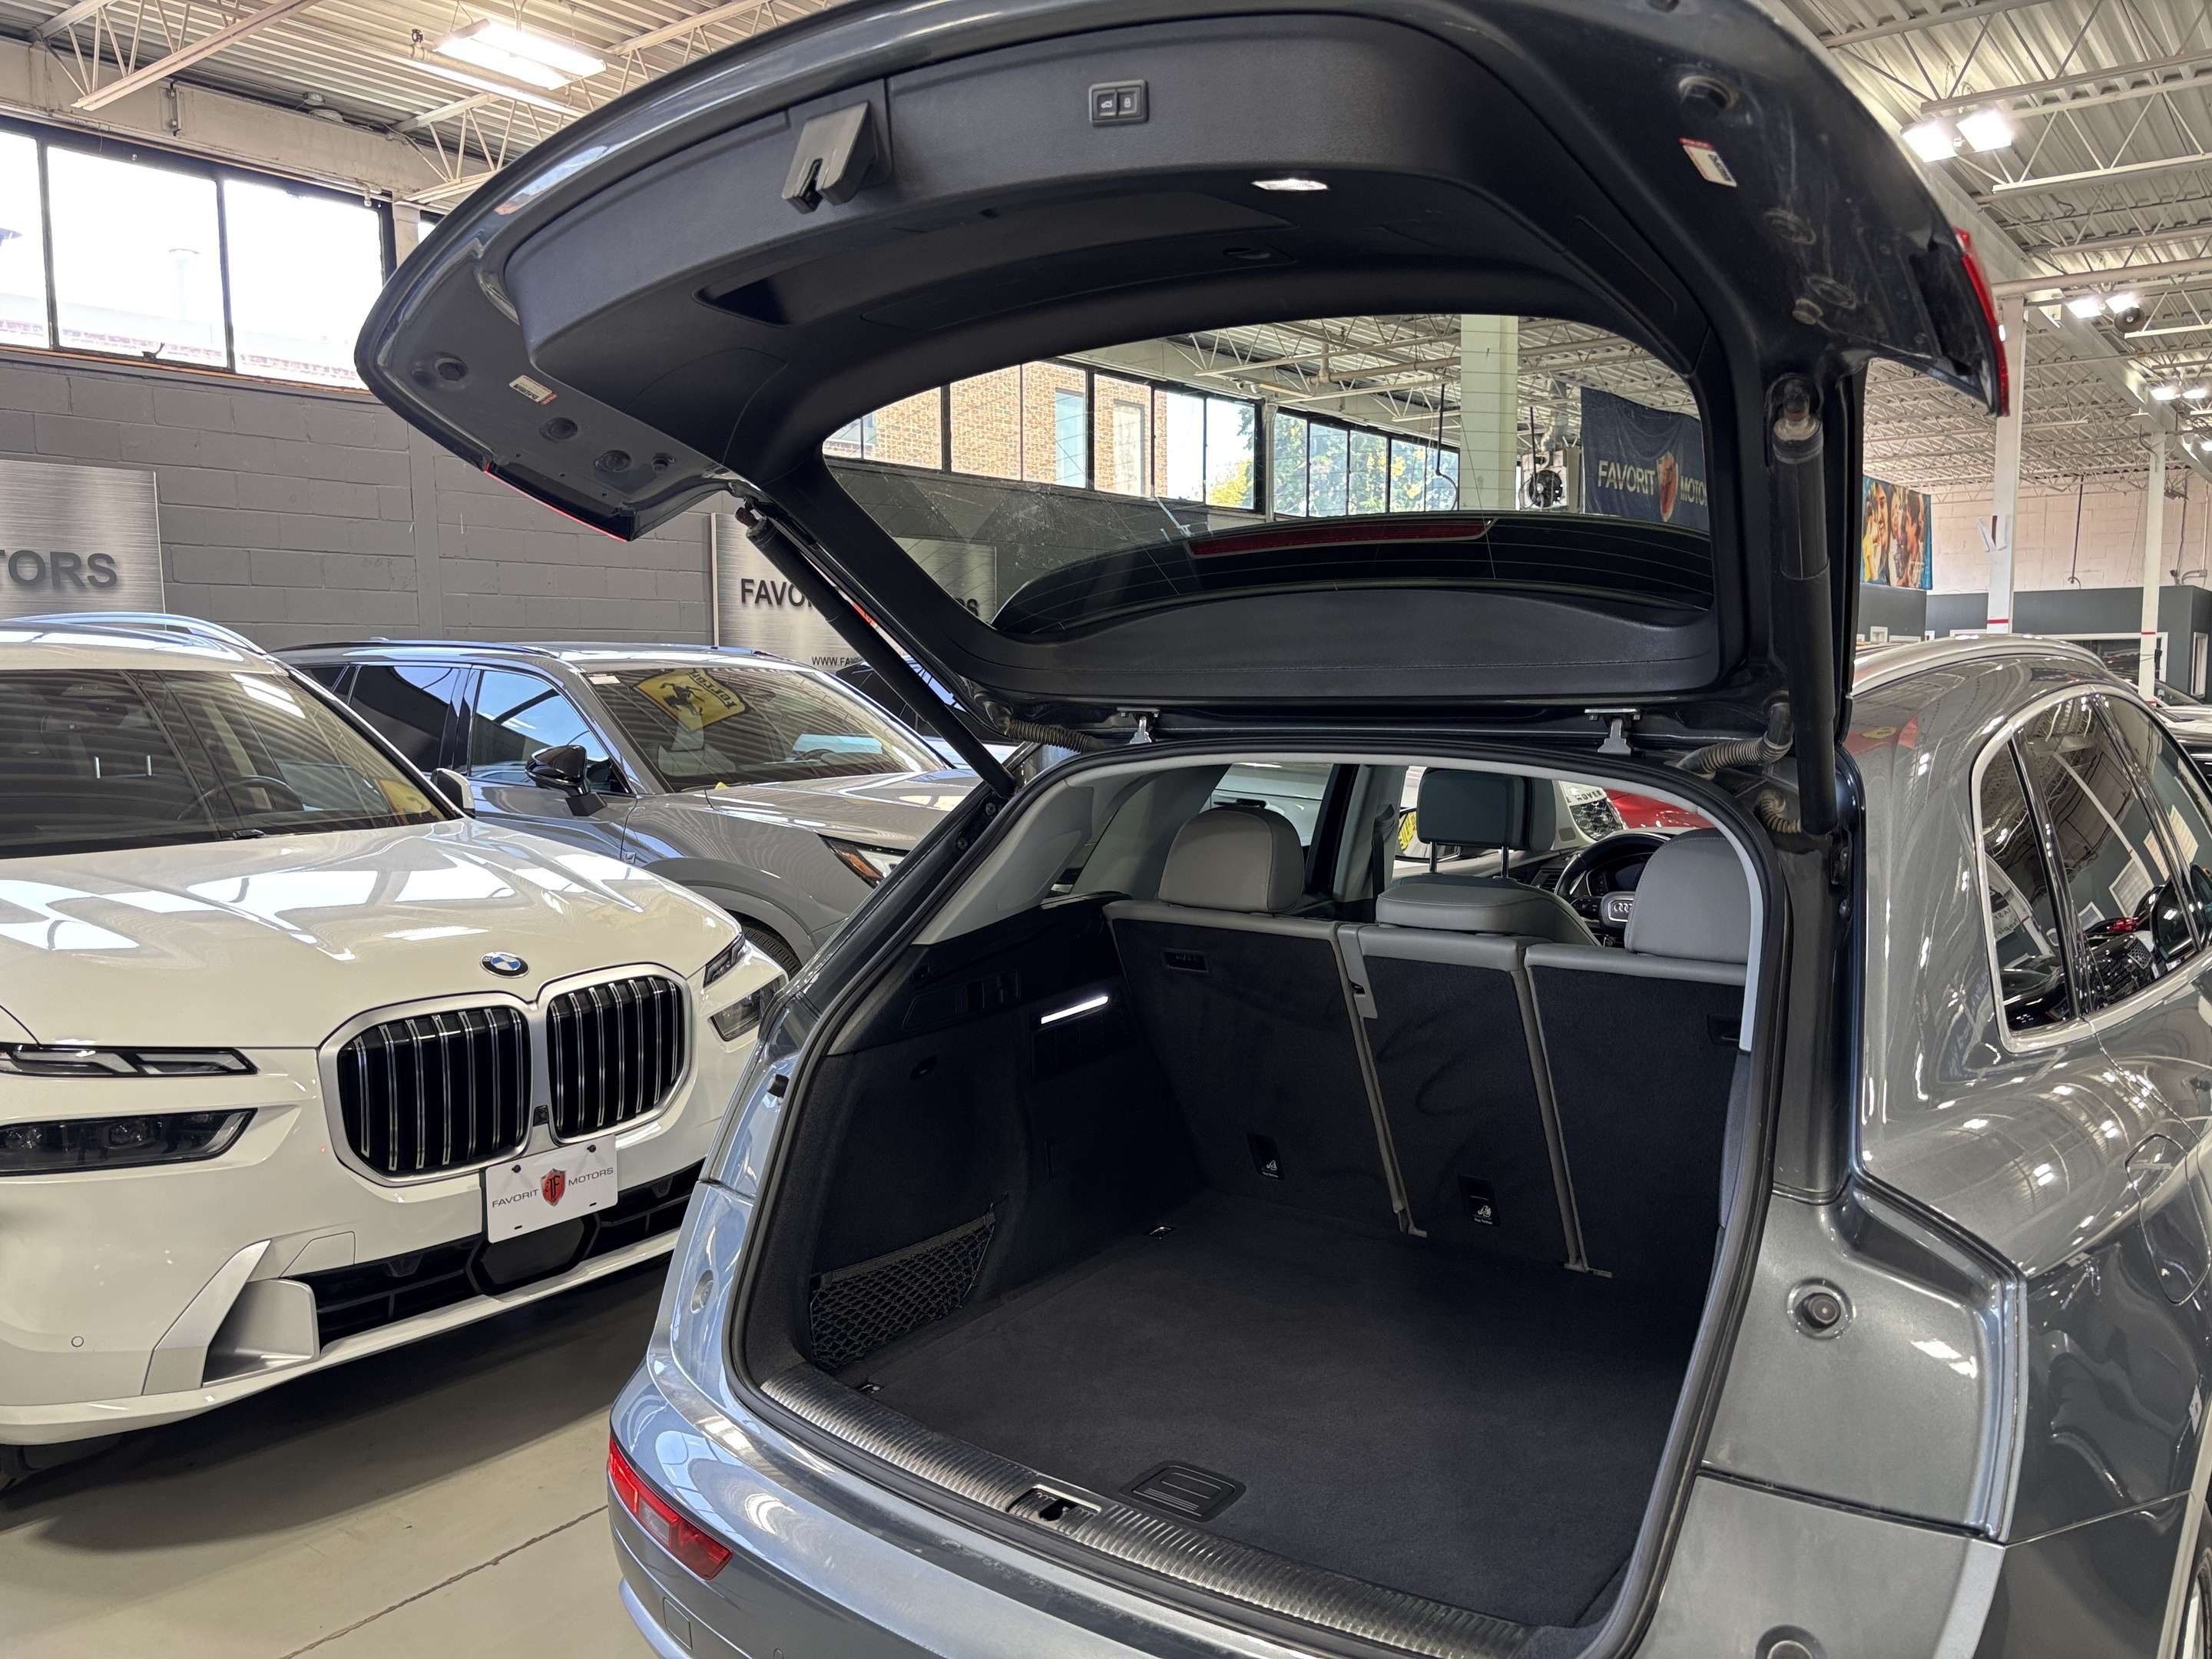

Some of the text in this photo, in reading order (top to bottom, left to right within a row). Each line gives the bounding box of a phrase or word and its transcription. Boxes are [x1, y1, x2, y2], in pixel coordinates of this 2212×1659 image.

[1598, 460, 1707, 508] FAVORIT MOTO
[0, 547, 118, 590] ORS
[740, 578, 812, 608] FAVO
[492, 1188, 539, 1208] FAVORIT
[568, 1167, 614, 1187] MOTORS
